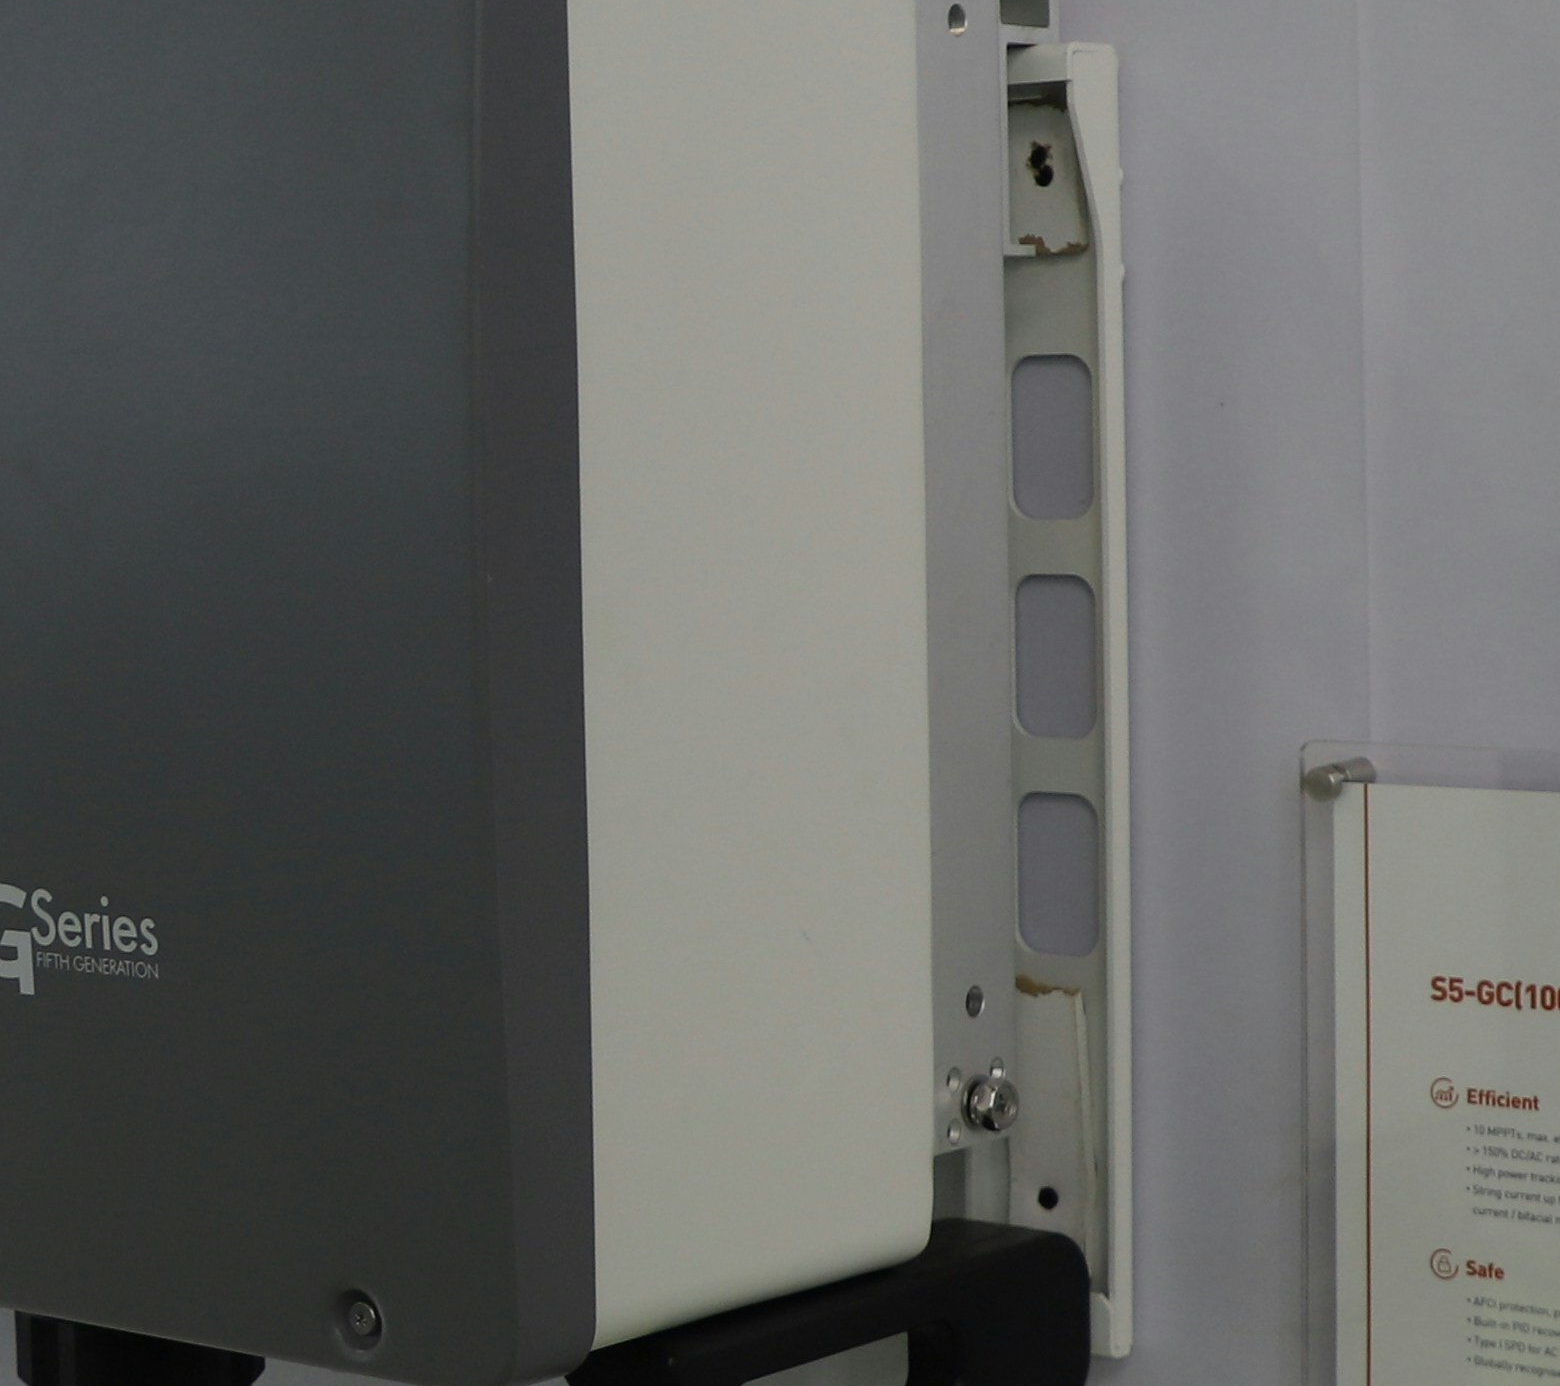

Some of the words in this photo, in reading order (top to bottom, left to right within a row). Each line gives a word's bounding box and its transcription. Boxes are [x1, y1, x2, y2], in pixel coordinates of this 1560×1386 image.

[31, 888, 159, 956] Series
[36, 952, 71, 971] FIFTH
[72, 955, 160, 979] GENERATION
[1466, 1088, 1540, 1111] Efficient
[1473, 1165, 1495, 1178] High
[1498, 1169, 1527, 1180] power
[1473, 1185, 1502, 1200] String
[1504, 1190, 1541, 1203] current
[1543, 1195, 1556, 1205] up
[1472, 1206, 1509, 1218] current
[1465, 1259, 1506, 1281] Safe
[1473, 1335, 1497, 1350] Type
[1528, 1343, 1542, 1354] for
[1473, 1354, 1513, 1372] Globally
